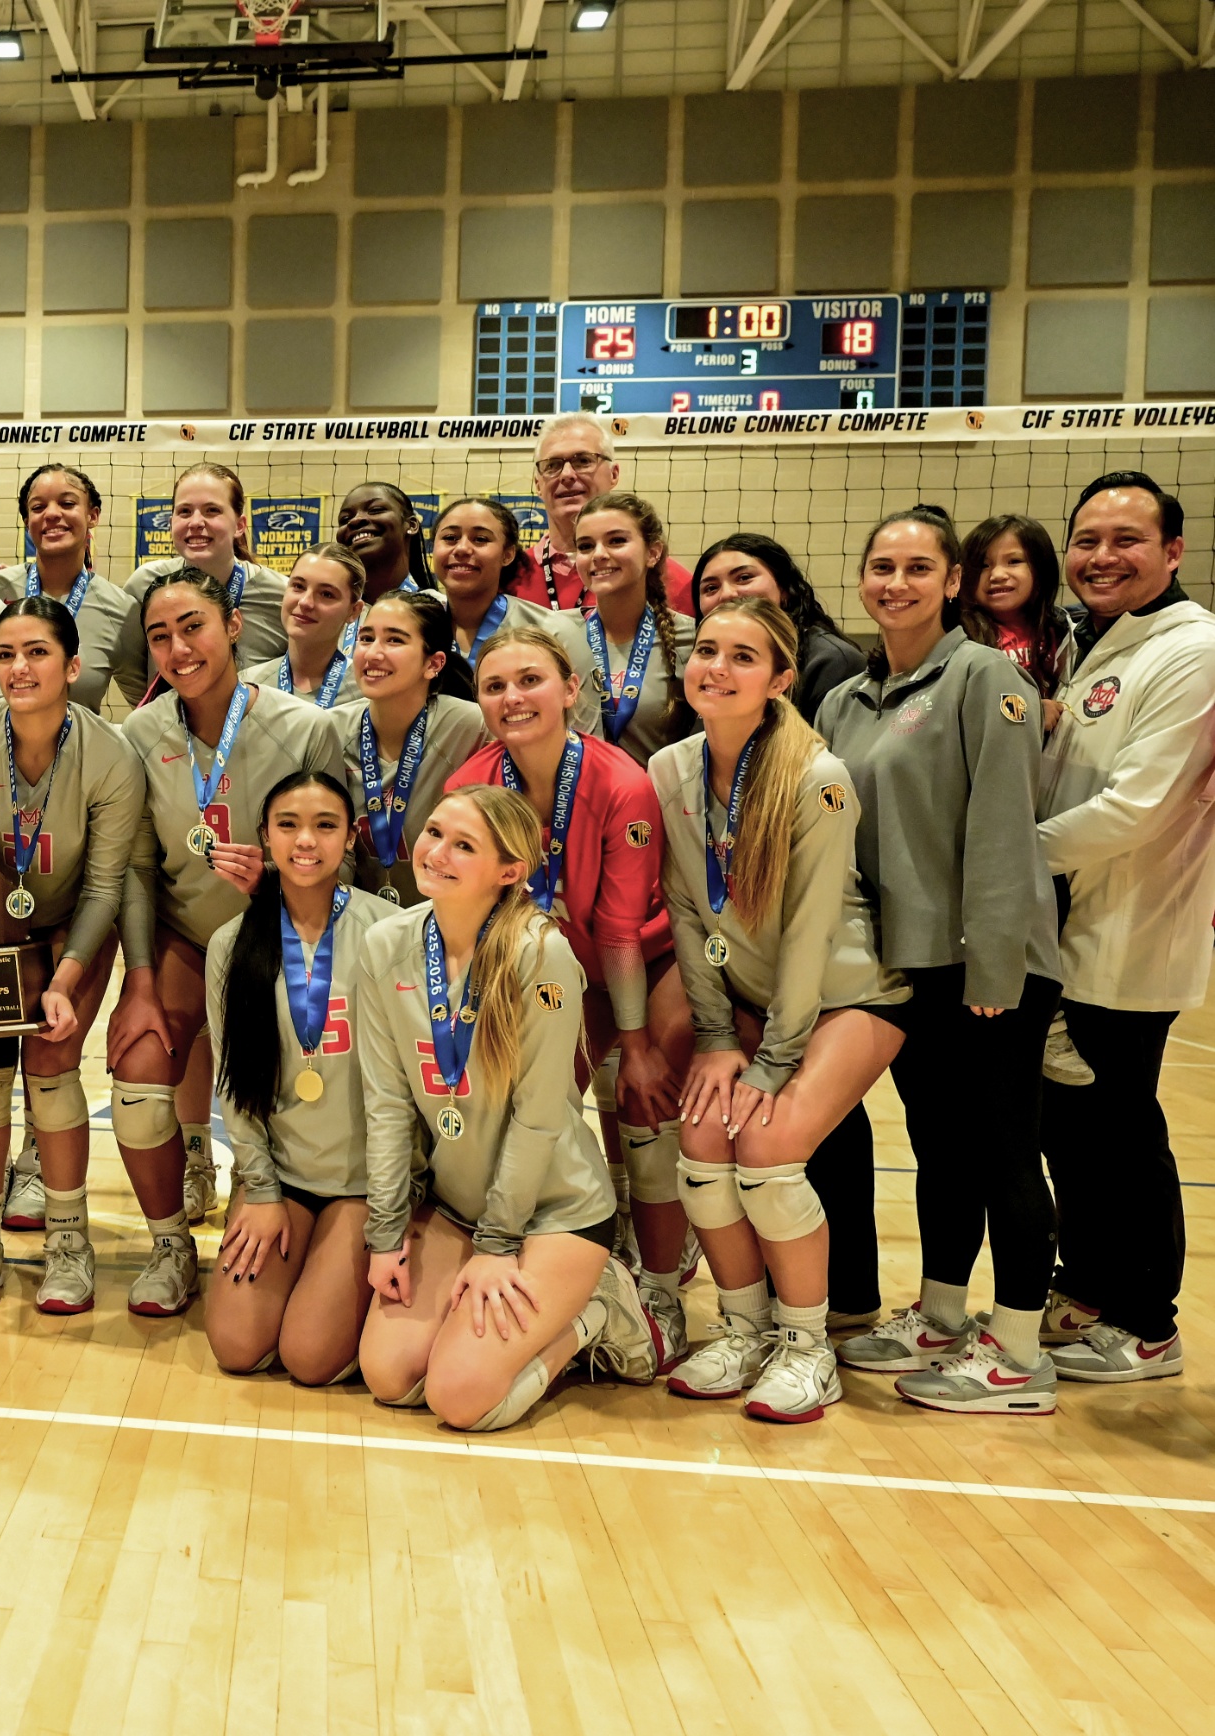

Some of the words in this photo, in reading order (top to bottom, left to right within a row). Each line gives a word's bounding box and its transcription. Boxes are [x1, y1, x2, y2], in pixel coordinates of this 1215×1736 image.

[909, 294, 925, 305] NO
[941, 294, 948, 304] F
[964, 293, 985, 303] PTS
[485, 304, 500, 315] NO
[514, 303, 522, 314] F
[536, 303, 556, 314] PTS
[585, 306, 635, 323] HOME
[812, 301, 882, 318] VISITOR
[708, 305, 781, 338] 1:00
[593, 327, 635, 359] 25
[761, 342, 783, 350] POSS
[843, 322, 874, 354] 18
[670, 344, 692, 352] POSS
[695, 355, 735, 366] PERIOD
[740, 349, 757, 374] 3
[819, 360, 857, 371] BONUS
[598, 364, 634, 375] BONUS
[579, 383, 613, 394] FOULS
[840, 379, 875, 390] FOULS
[697, 394, 753, 407] TIMEOUTS
[665, 414, 737, 435] BELONG
[744, 412, 833, 433] CONNECT
[838, 411, 928, 431] COMPETE
[1022, 407, 1053, 429] CIF
[1060, 406, 1126, 428] STATE
[1133, 404, 1215, 427] VOLLEYB
[68, 424, 147, 442] COMPETE
[229, 423, 256, 441] CIF
[262, 422, 317, 440] STATE
[324, 421, 429, 439] VOLLEYBALL
[437, 420, 545, 439] CHAMPIONS
[259, 530, 312, 543] WOMEN'S
[629, 615, 653, 678] 2025-2026
[222, 690, 245, 750] CHAMPIONSHIPS
[362, 718, 377, 789] 2025-2026
[399, 716, 426, 788] CHAMPIONSHIPS
[554, 749, 578, 830] CHAMPIONSHIPS
[415, 1039, 472, 1097] 2
